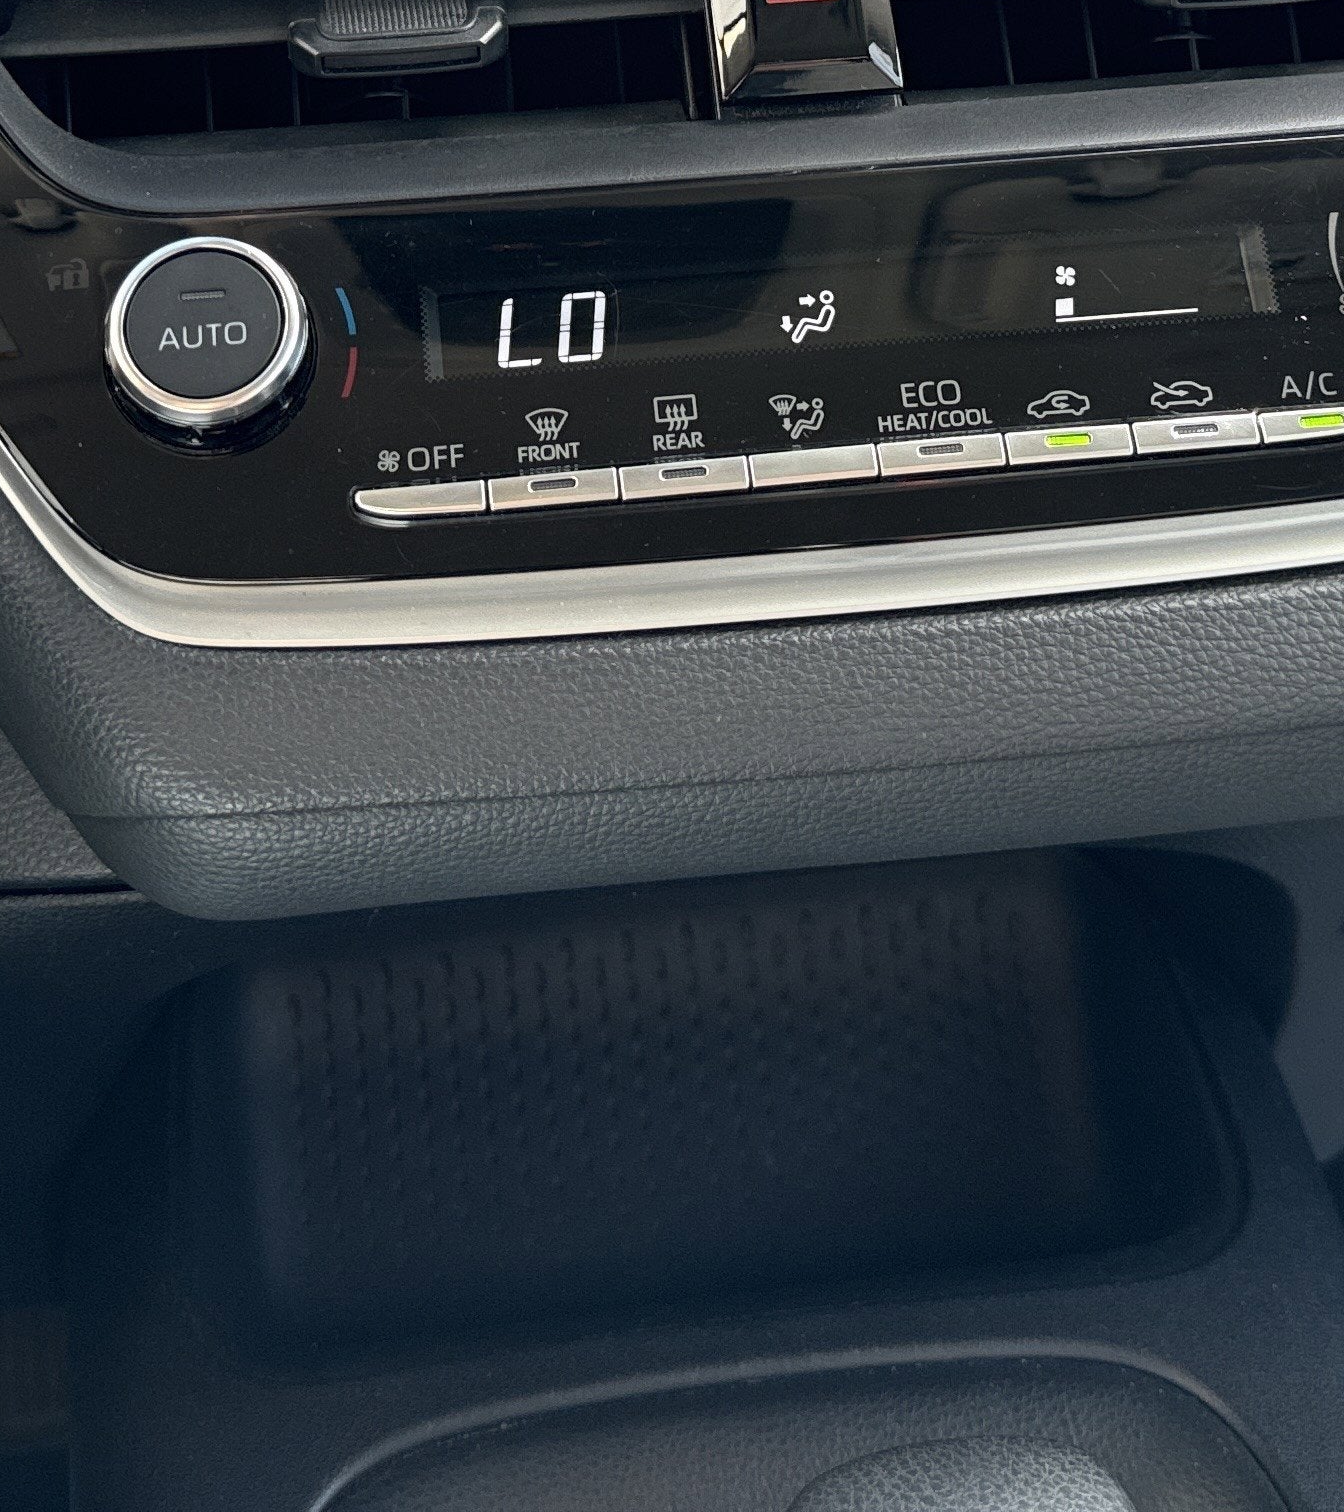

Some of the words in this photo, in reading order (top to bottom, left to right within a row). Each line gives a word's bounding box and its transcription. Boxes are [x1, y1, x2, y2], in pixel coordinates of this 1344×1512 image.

[158, 320, 248, 352] AUTO
[497, 289, 607, 369] LO
[899, 379, 963, 408] ECO
[1281, 370, 1338, 400] A/C
[877, 407, 994, 433] HEAT/COOL
[516, 441, 581, 463] FRONT
[652, 431, 706, 452] REAR
[407, 443, 465, 473] OFF
